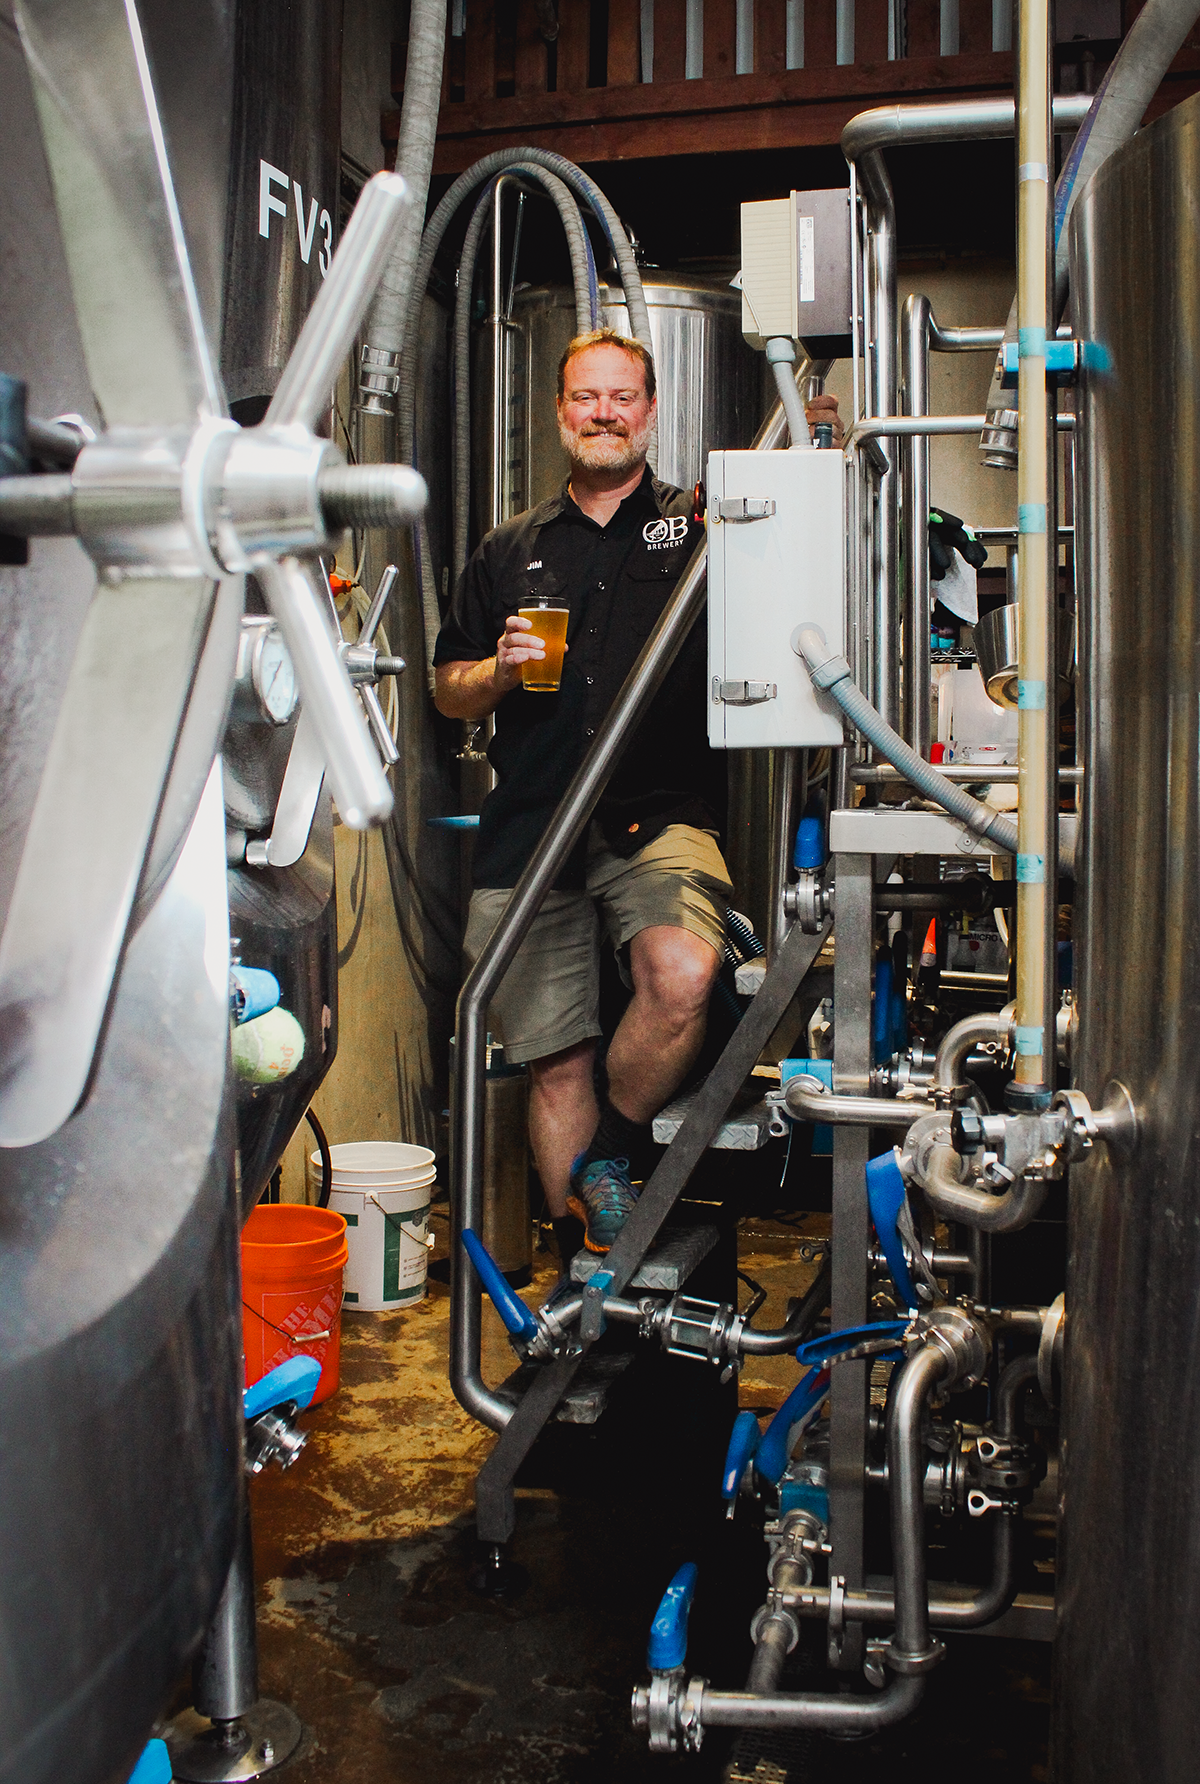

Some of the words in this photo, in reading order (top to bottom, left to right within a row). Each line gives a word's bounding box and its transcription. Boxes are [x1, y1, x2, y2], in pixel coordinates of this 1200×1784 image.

[258, 158, 333, 280] FV3
[647, 539, 684, 551] BREWERY
[526, 560, 543, 571] JIM
[970, 933, 998, 942] MICRO
[272, 1302, 312, 1339] THE
